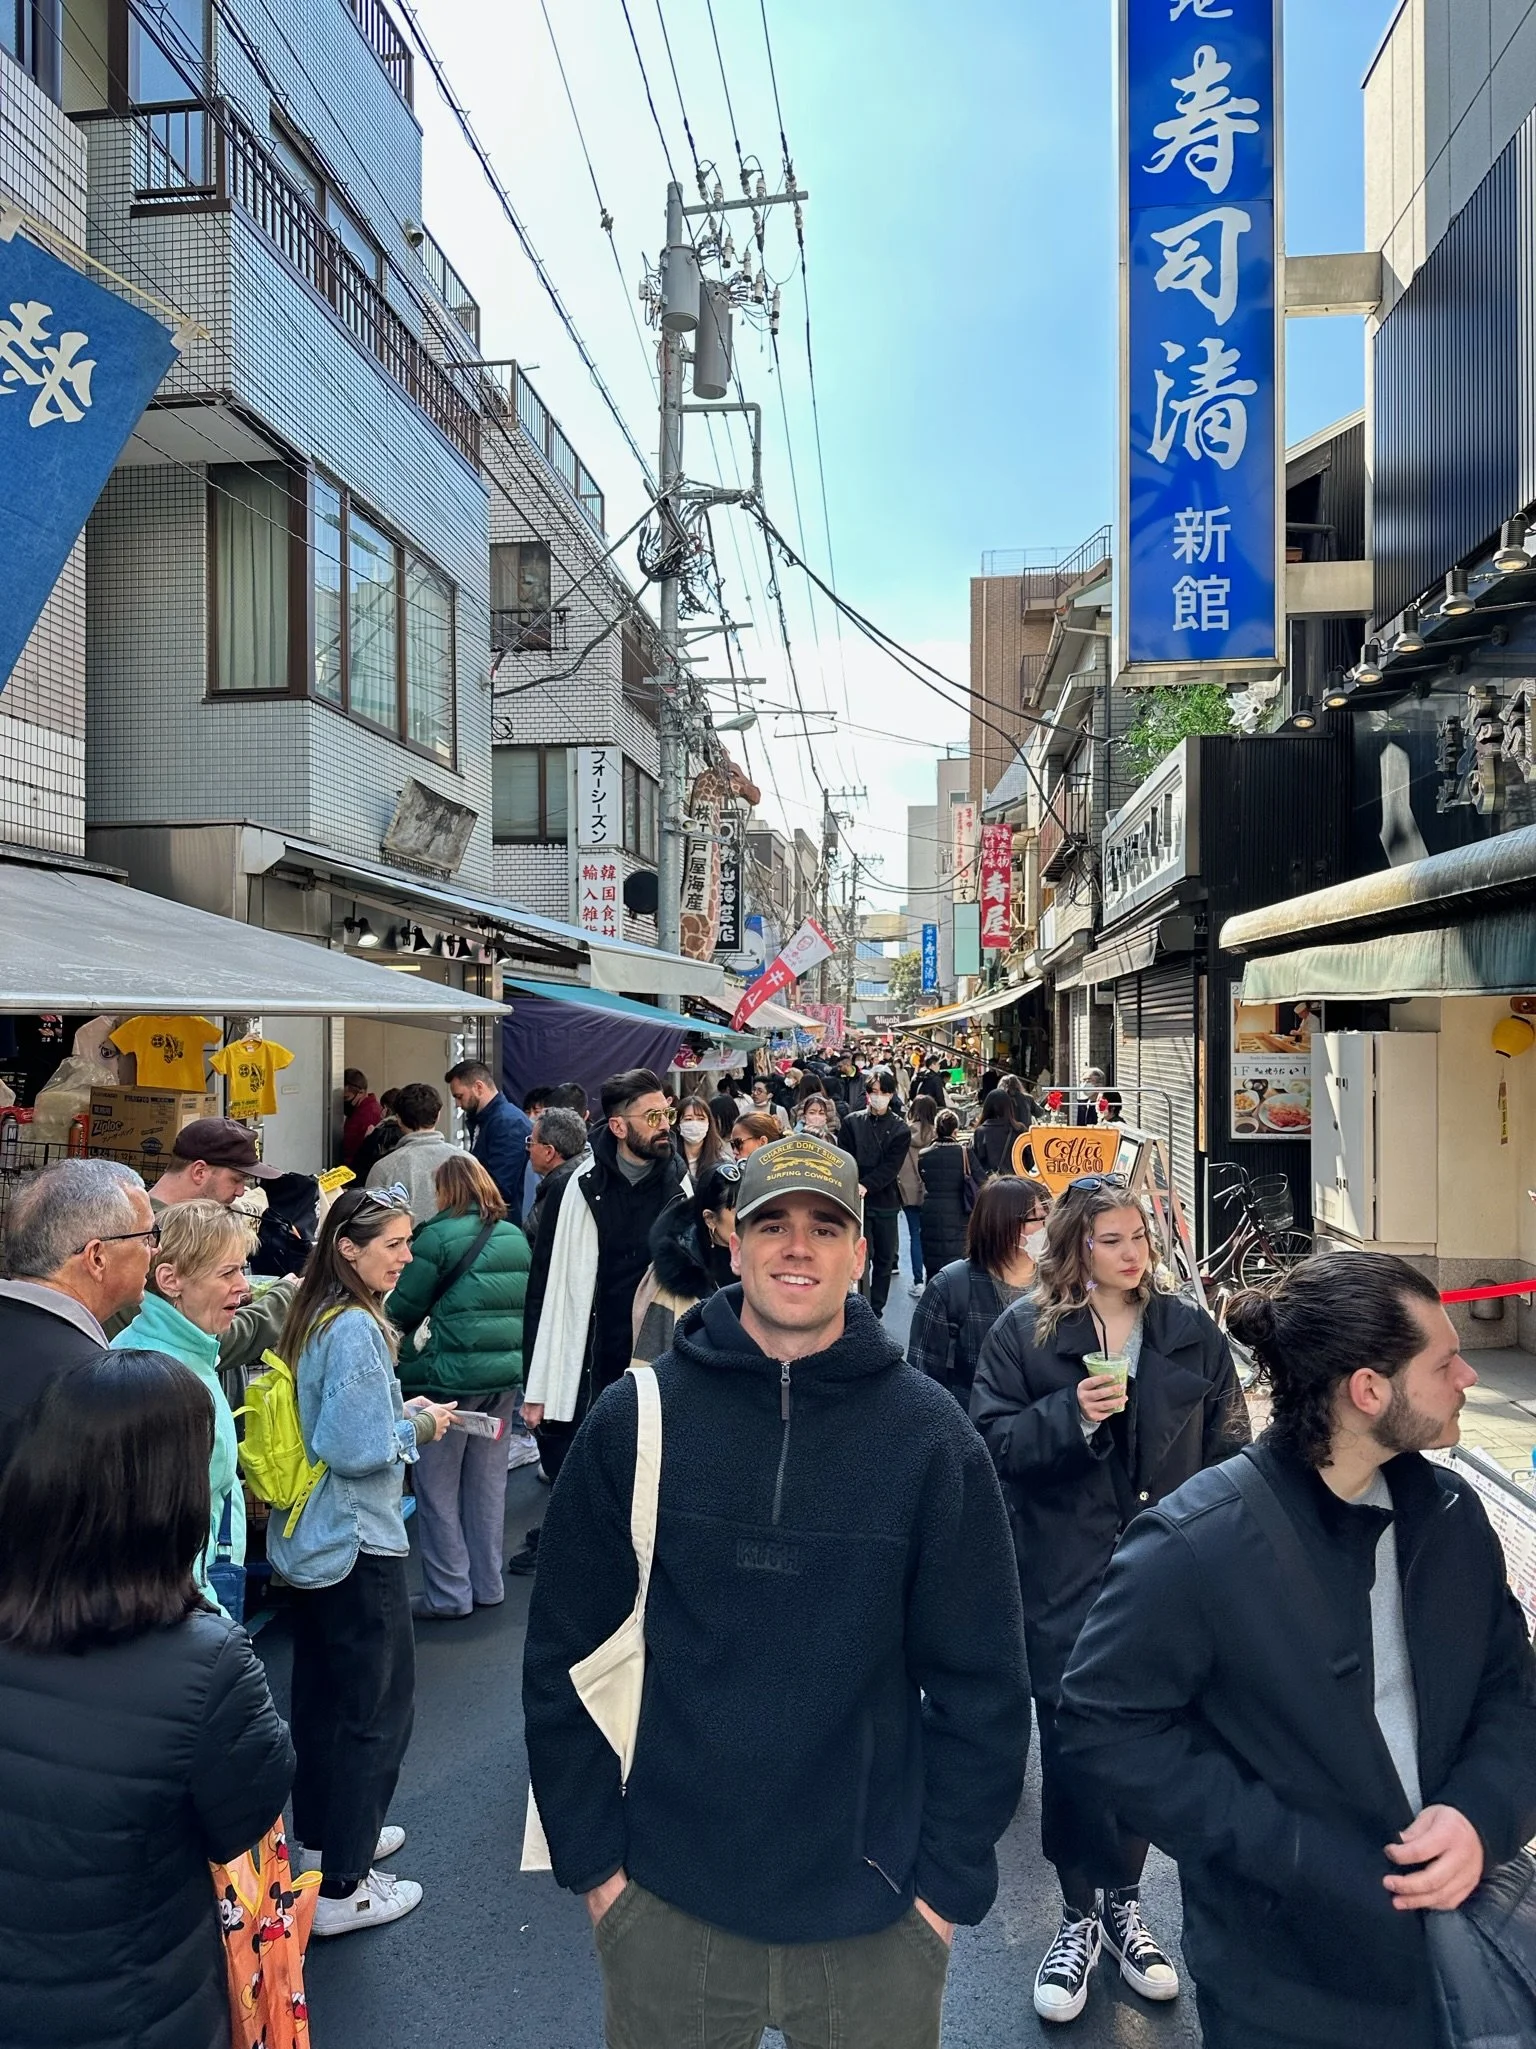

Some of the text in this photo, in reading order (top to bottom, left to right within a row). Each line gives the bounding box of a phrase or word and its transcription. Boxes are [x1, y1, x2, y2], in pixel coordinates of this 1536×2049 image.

[1142, 0, 1260, 470] 寿司清
[1172, 505, 1231, 632] 新館
[591, 750, 607, 844] フォーシーズン
[983, 871, 1010, 937] 寿屋
[874, 1015, 900, 1026] Miyabi
[91, 1119, 124, 1137] Ziploc
[762, 1141, 842, 1166] CHARLIE DON'T SURF
[1044, 1137, 1102, 1166] Coffee
[766, 1170, 842, 1187] SURFING COWBOYS
